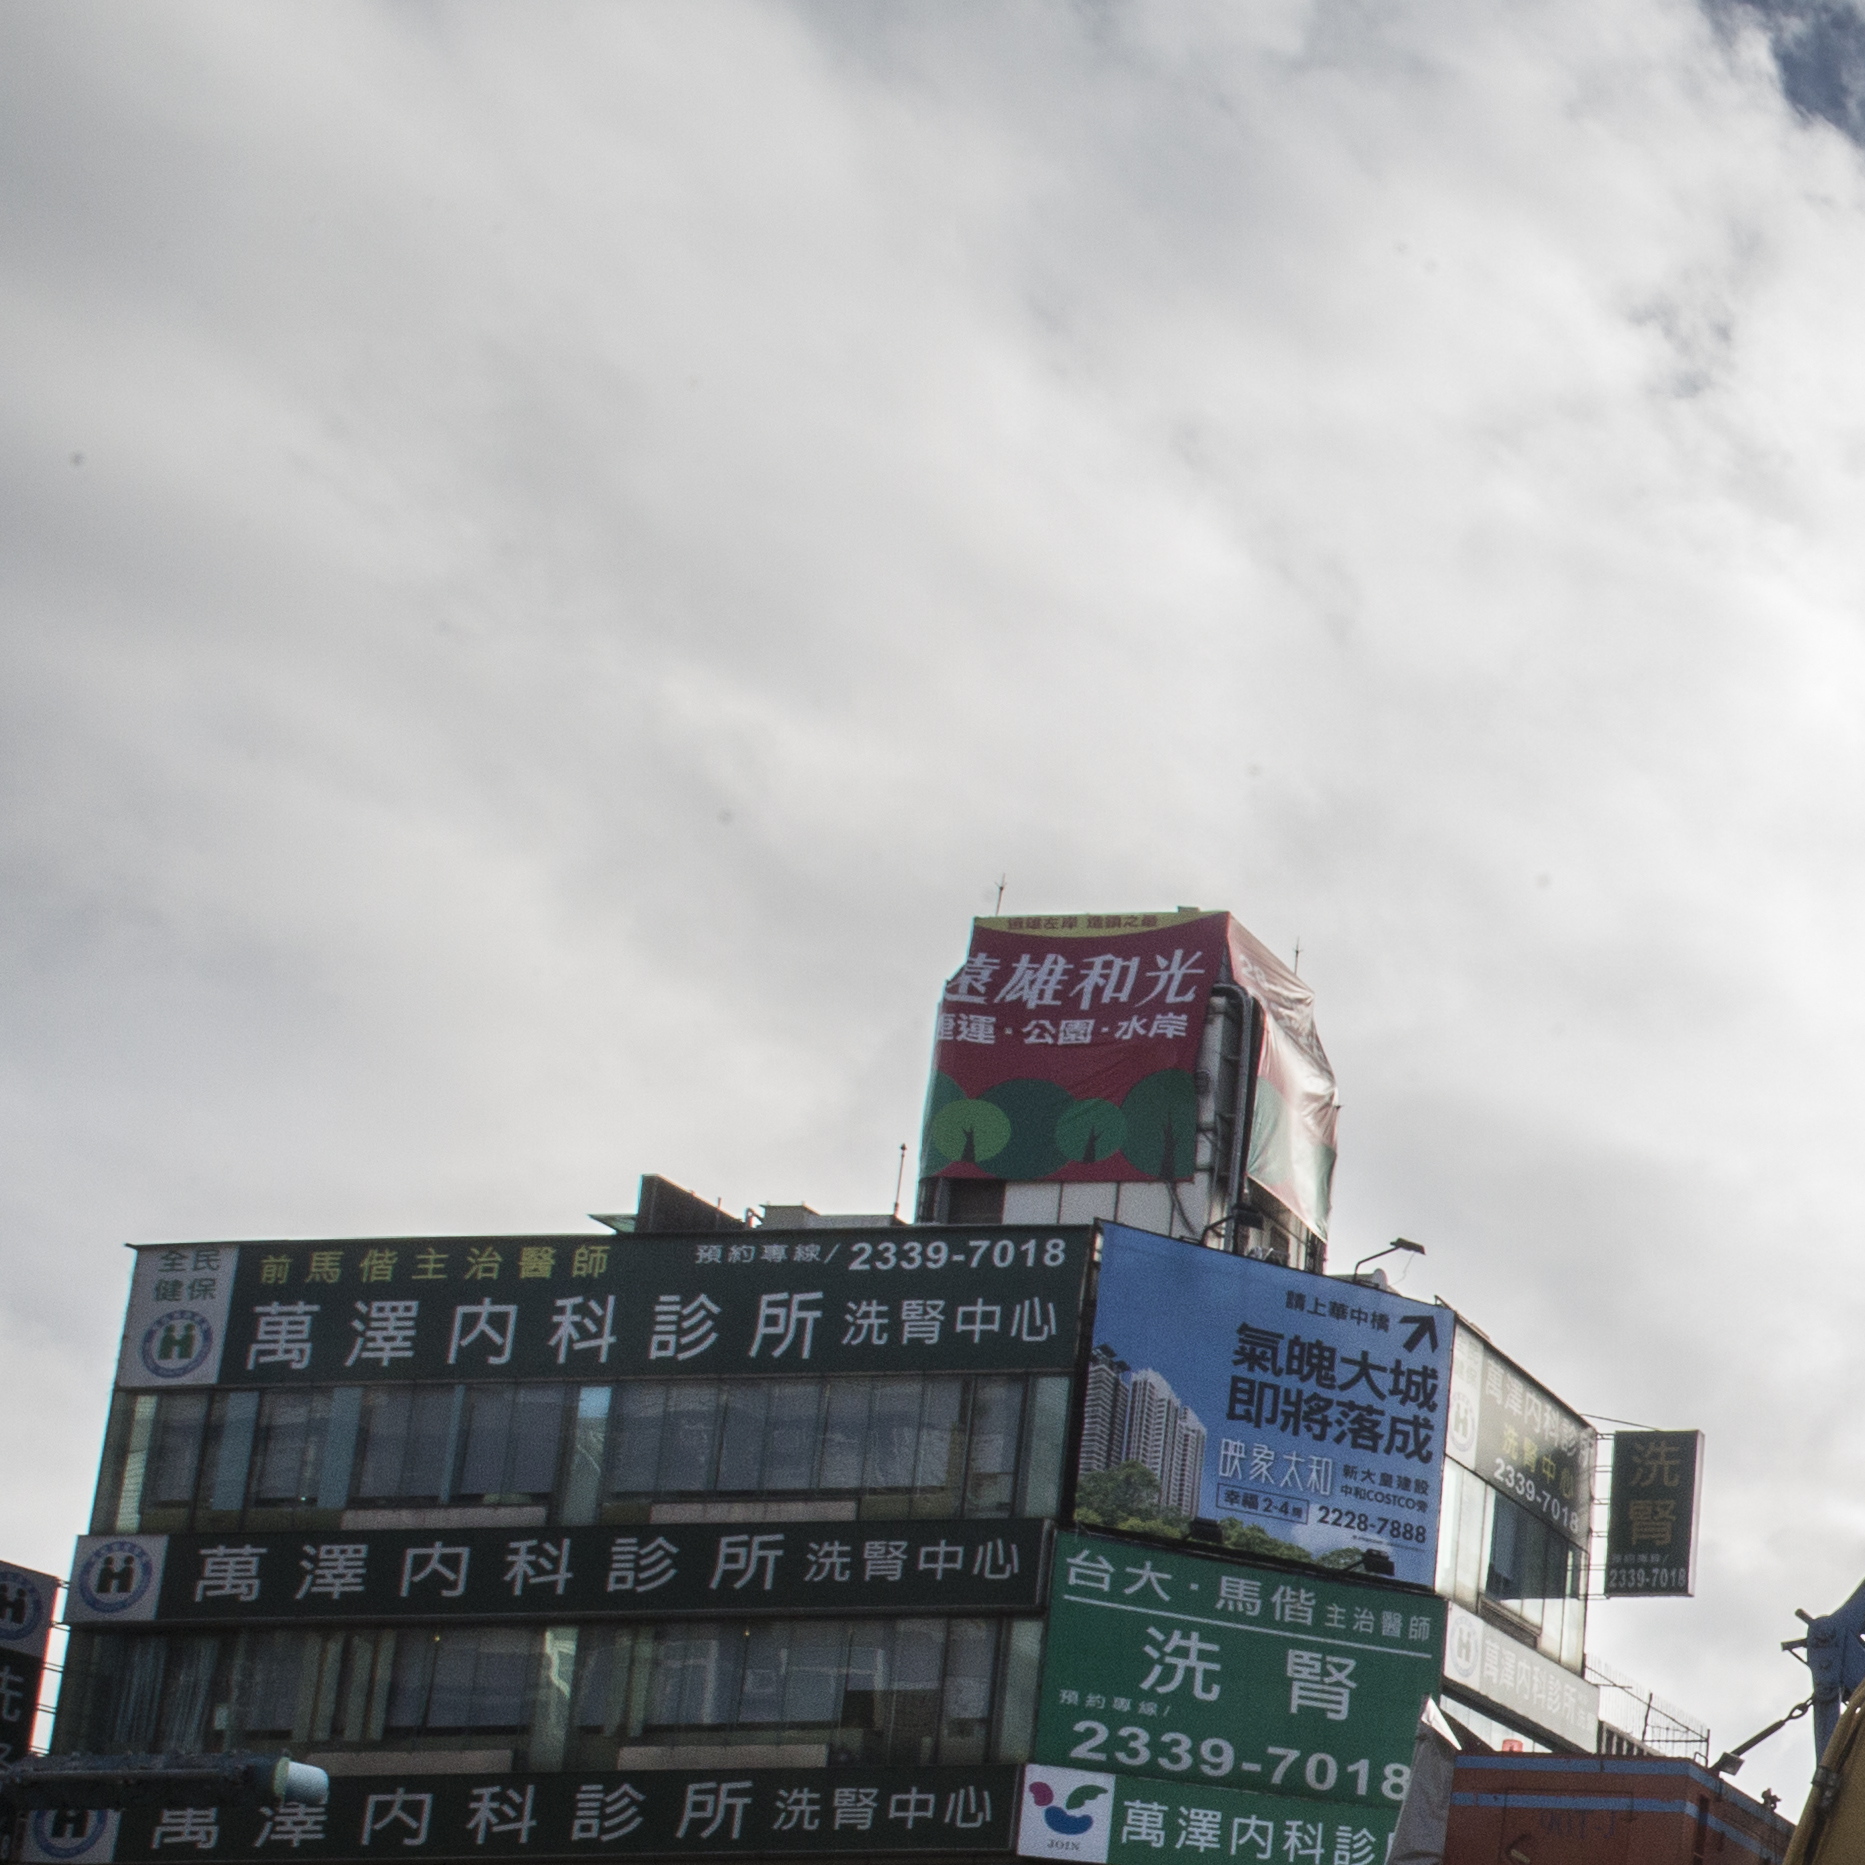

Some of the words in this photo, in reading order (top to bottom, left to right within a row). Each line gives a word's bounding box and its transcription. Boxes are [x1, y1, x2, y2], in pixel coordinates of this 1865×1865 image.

[944, 948, 1206, 1010] 遠雄和光
[258, 1244, 611, 1284] 前馬偕主治醫師
[848, 1238, 1066, 1271] 2339-7018
[841, 1297, 1056, 1346] 洗腎中心
[1285, 1290, 1390, 1333] 請上華中橋
[1231, 1322, 1440, 1413] 氣魄大城
[1225, 1374, 1434, 1464] 即將落成
[1217, 1438, 1336, 1497] 映象太和
[1493, 1457, 1581, 1535] 2339-7018
[1626, 1440, 1682, 1547] 洗腎
[1317, 1505, 1428, 1545] 2228-7888
[804, 1538, 1019, 1583] 洗腎中心
[1608, 1566, 1687, 1588] 2339-7018
[1325, 1603, 1431, 1642] 主治醫師
[1138, 1625, 1358, 1722] 洗腎
[1069, 1720, 1411, 1801] 2339-7018
[772, 1785, 992, 1832] 洗腎中心
[1046, 1838, 1081, 1852] JOIN
